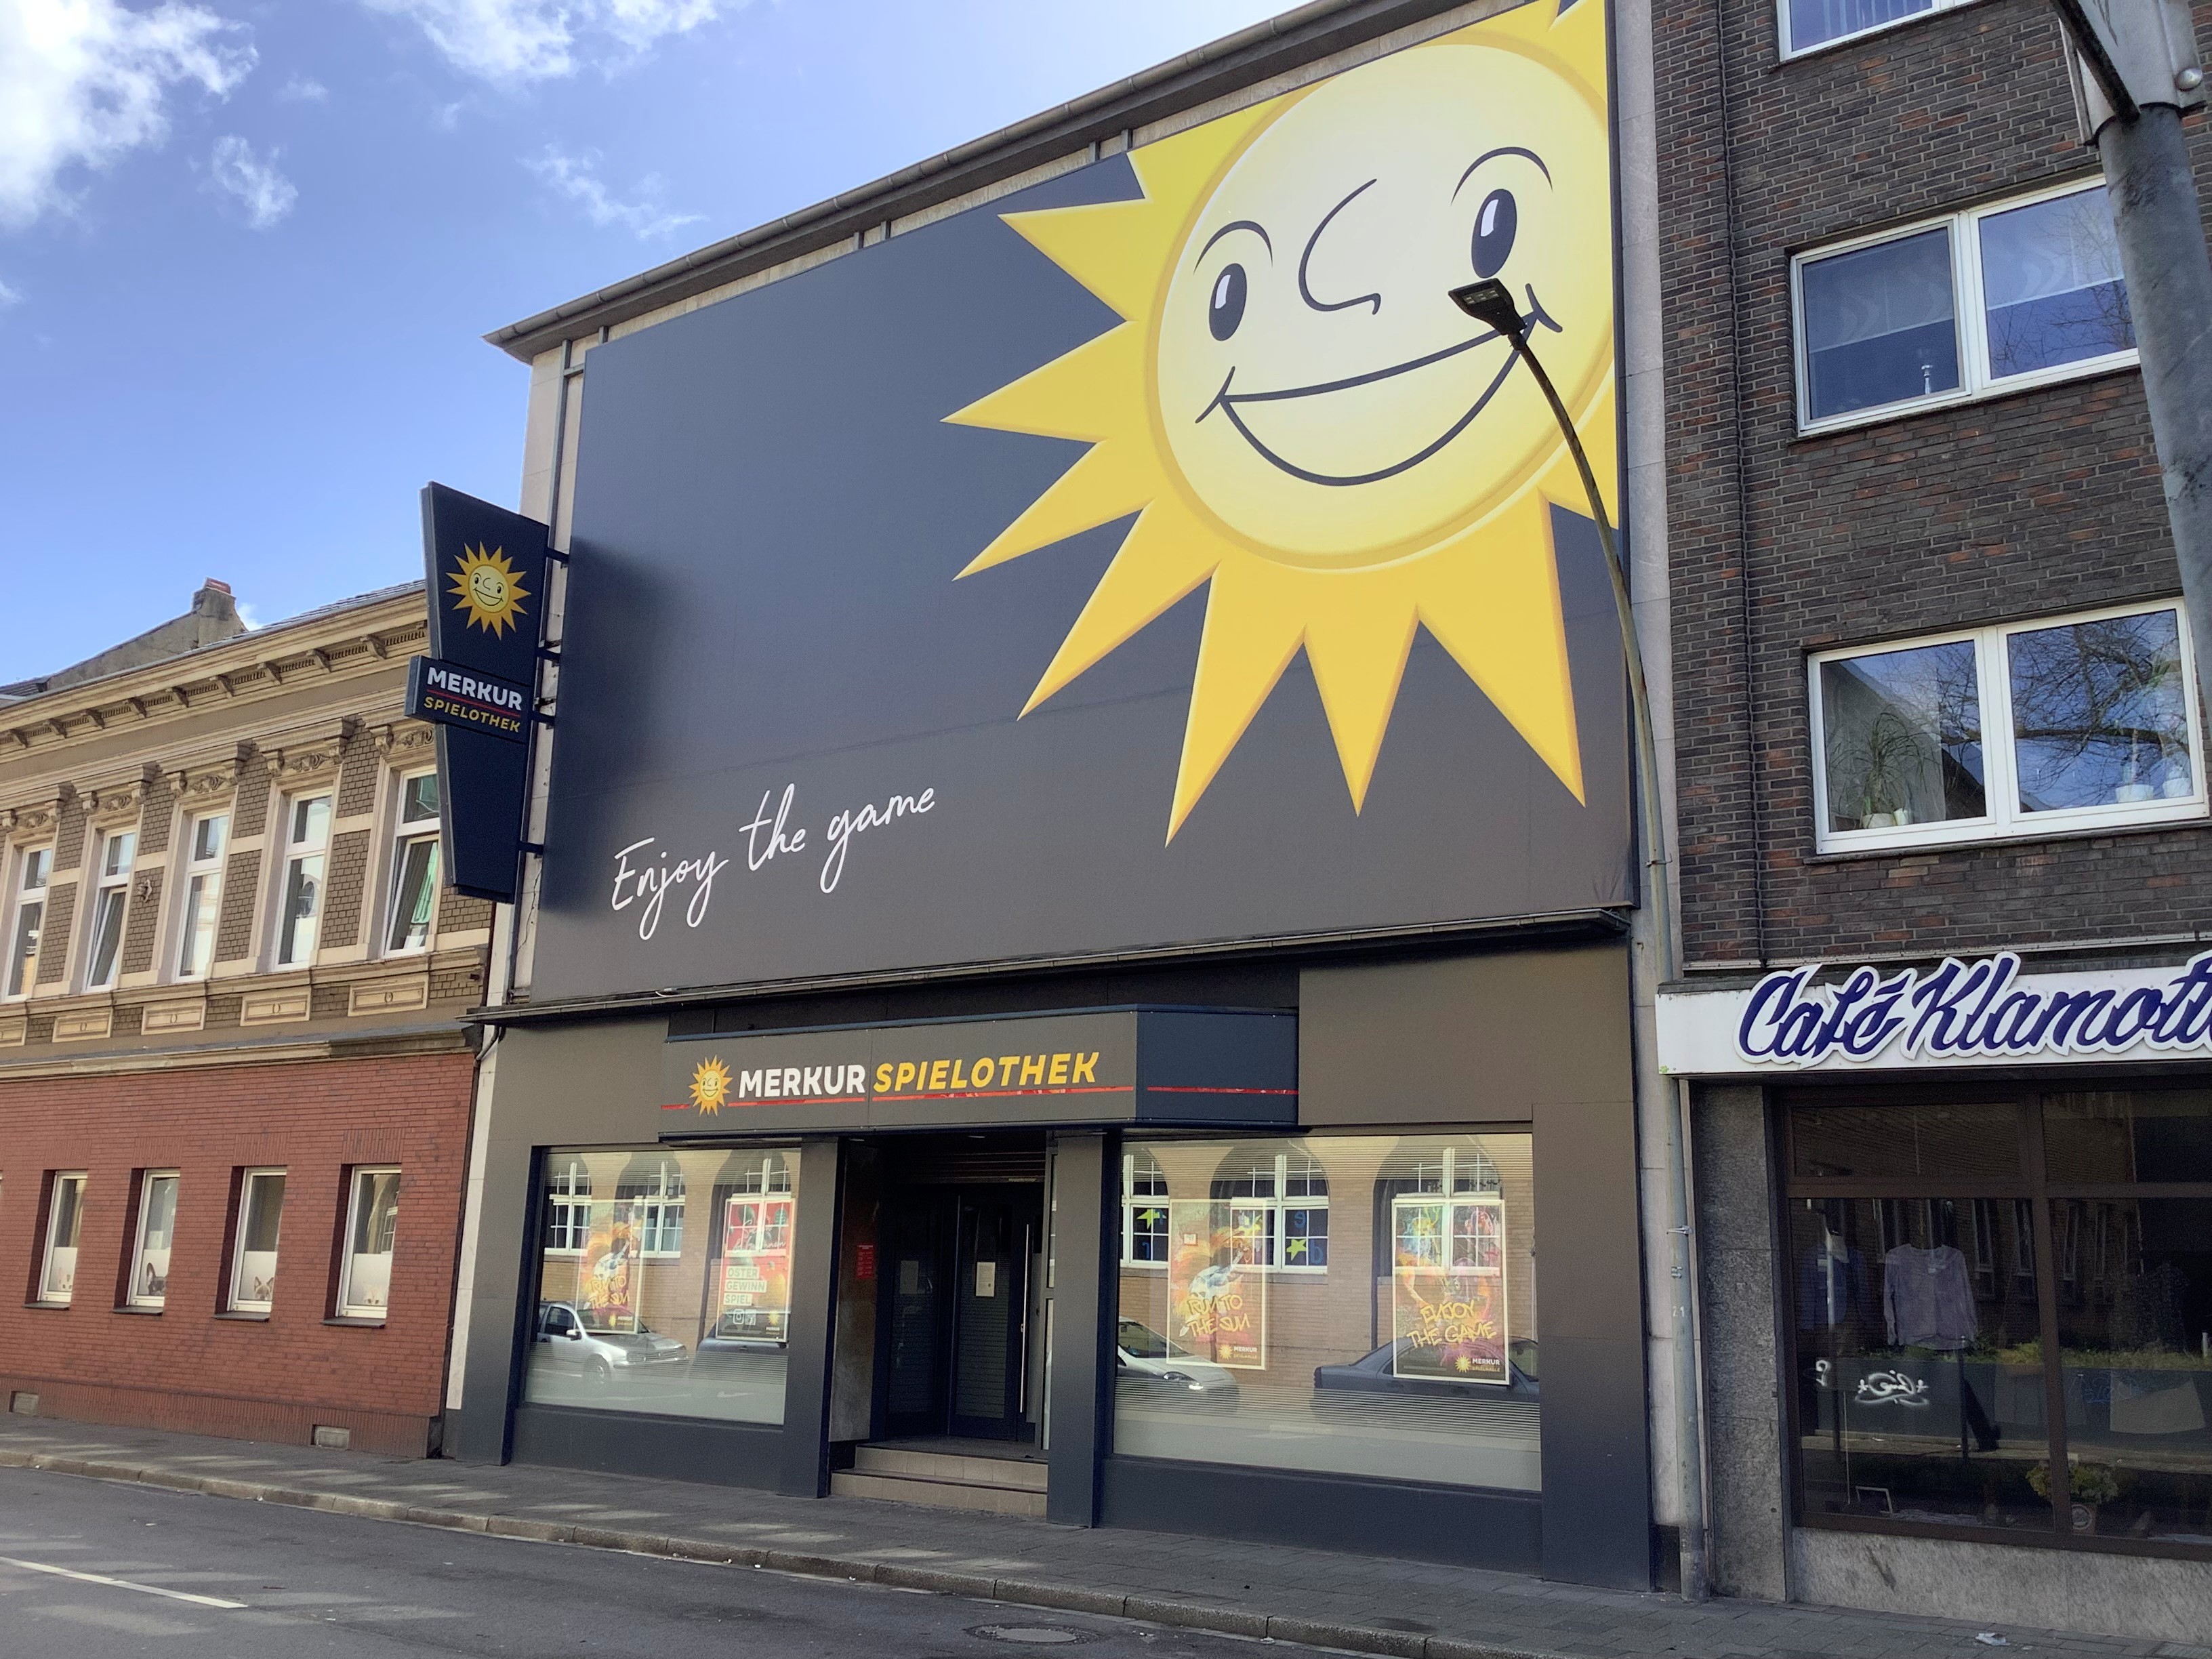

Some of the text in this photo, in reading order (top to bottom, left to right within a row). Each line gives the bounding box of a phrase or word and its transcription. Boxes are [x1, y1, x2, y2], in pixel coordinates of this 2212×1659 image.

[426, 666, 523, 711] MERKUR
[424, 696, 520, 733] SPIELOTHEK
[611, 783, 935, 940] Enjoy the game
[1738, 951, 2212, 1059] Café Klamott
[739, 1051, 1099, 1099] MERKUR SPIELOTHEK
[611, 1275, 626, 1288] TO
[728, 1267, 758, 1279] OSTER
[726, 1281, 765, 1292] GEWINN
[589, 1294, 609, 1309] THE
[725, 1294, 751, 1304] SPIEL
[1187, 1294, 1243, 1315] RUN TO
[1420, 1299, 1475, 1324] ENJOY
[1187, 1313, 1250, 1337] THE SUN
[1406, 1321, 1497, 1349] THE GAME
[1472, 1357, 1500, 1366] MERKUR
